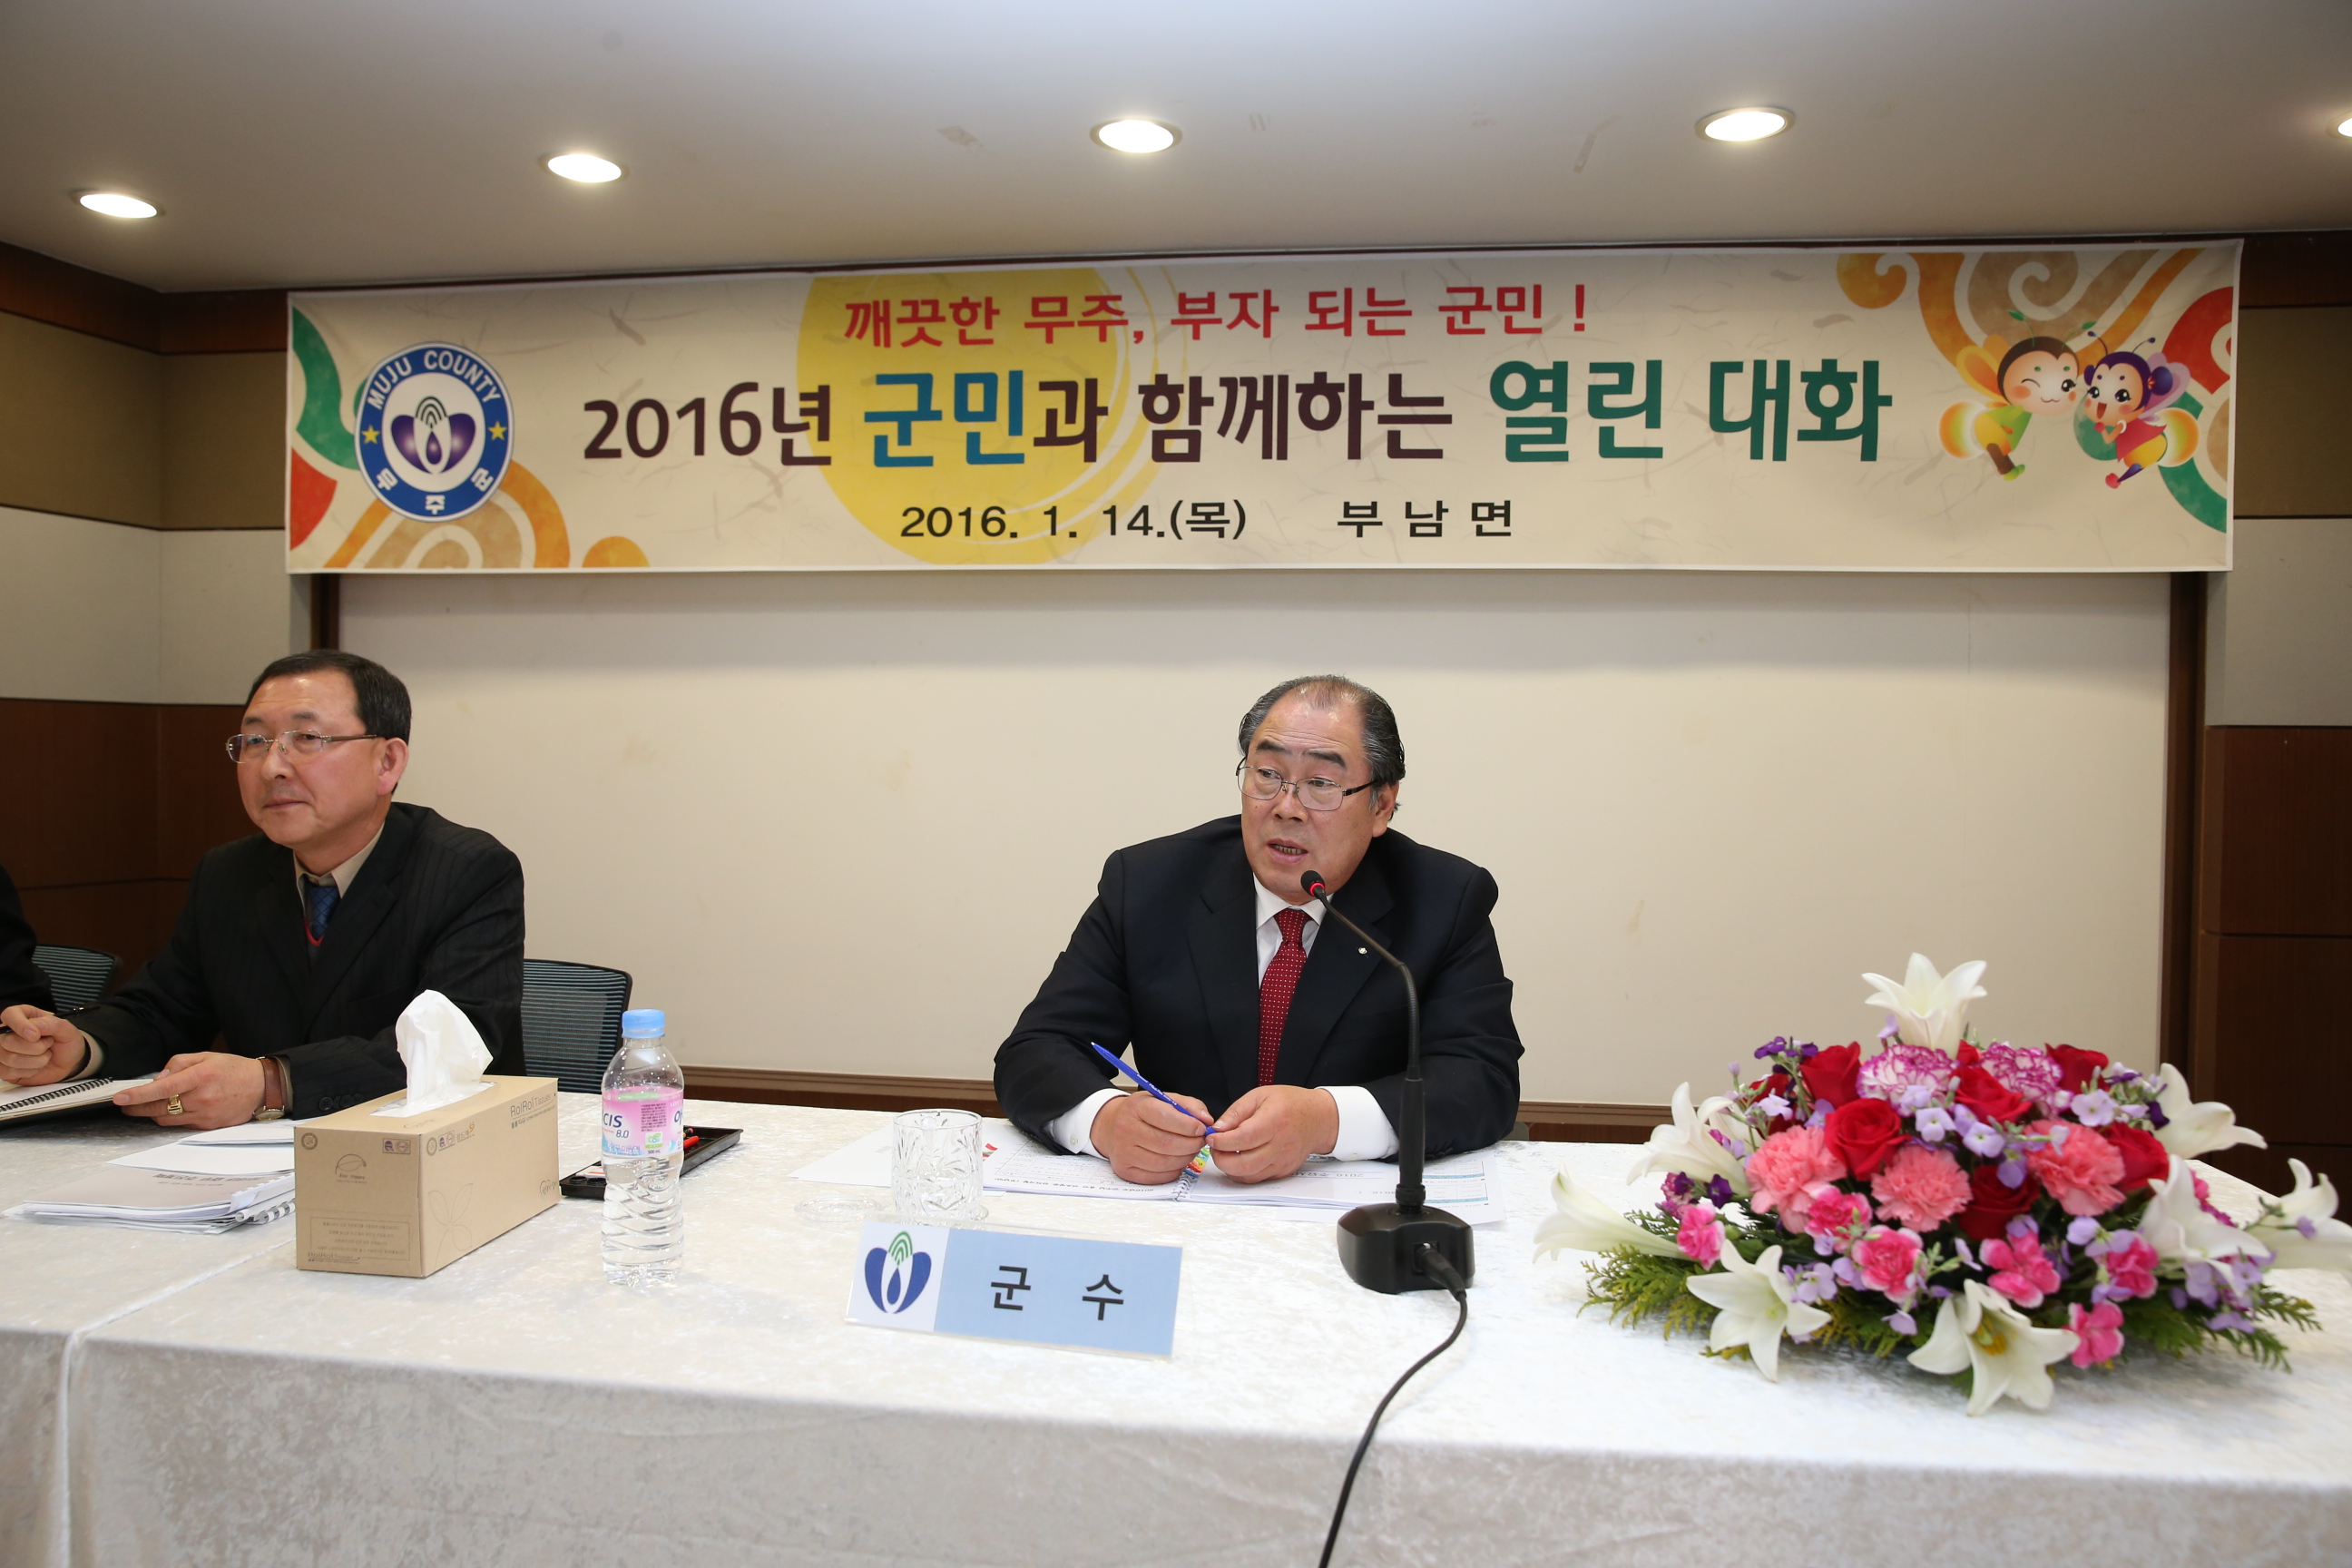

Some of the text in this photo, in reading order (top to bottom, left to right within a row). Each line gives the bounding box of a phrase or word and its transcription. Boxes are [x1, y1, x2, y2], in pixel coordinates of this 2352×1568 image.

[845, 296, 1000, 348] 깨끗한
[1024, 294, 1144, 344] 무주,
[1171, 289, 1279, 340] 부자
[1304, 287, 1412, 337] 되는
[1438, 284, 1543, 335] 군민
[367, 350, 502, 410] MUJU COUNTY
[584, 358, 1892, 467] 2016년 군민과 함께하는 열린 대화
[901, 500, 1246, 540] 2016. 1. 14.(목)
[616, 1130, 630, 1139] 8.0
